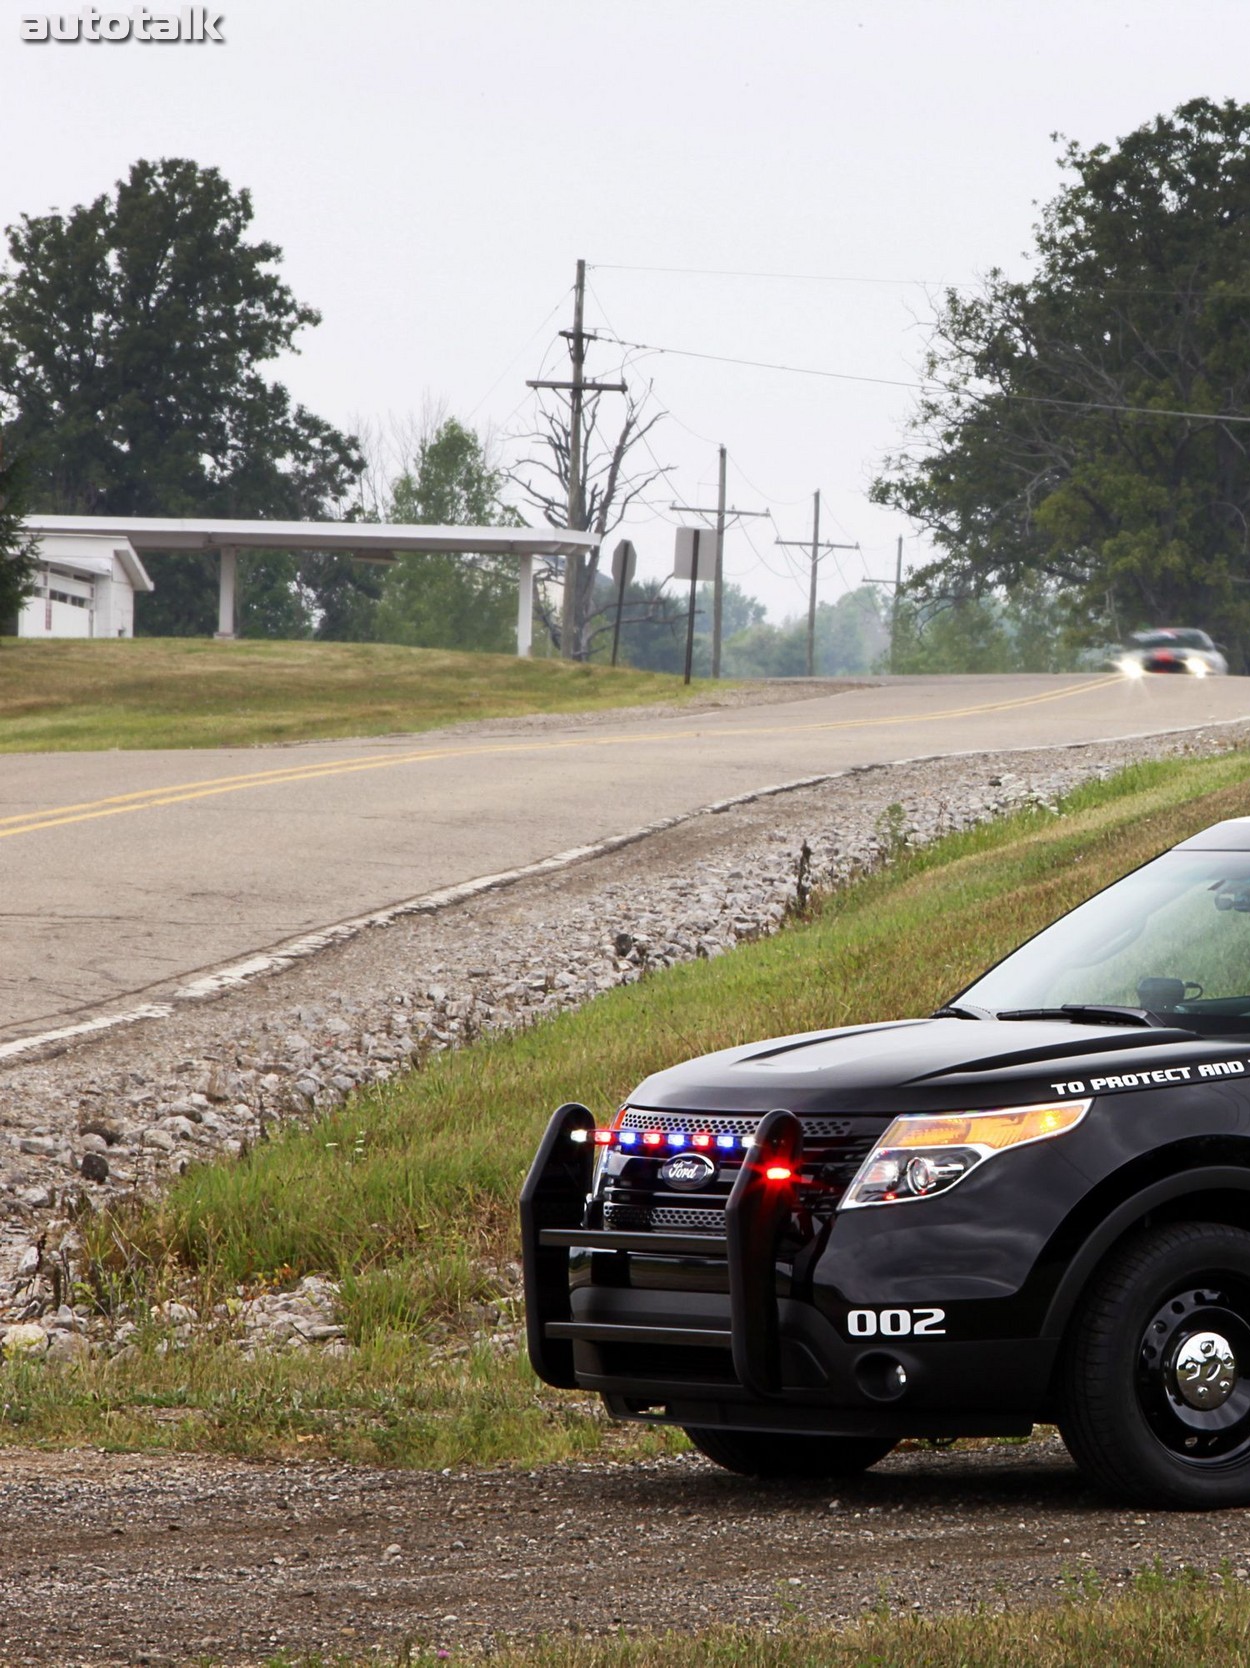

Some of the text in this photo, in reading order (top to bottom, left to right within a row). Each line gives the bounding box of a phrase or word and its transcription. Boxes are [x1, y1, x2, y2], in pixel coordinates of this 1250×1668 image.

[1050, 1082, 1086, 1096] TO
[1092, 1067, 1190, 1091] PROTECT
[1198, 1060, 1245, 1078] AND
[668, 1159, 699, 1179] Ford
[847, 1308, 946, 1336] 002
